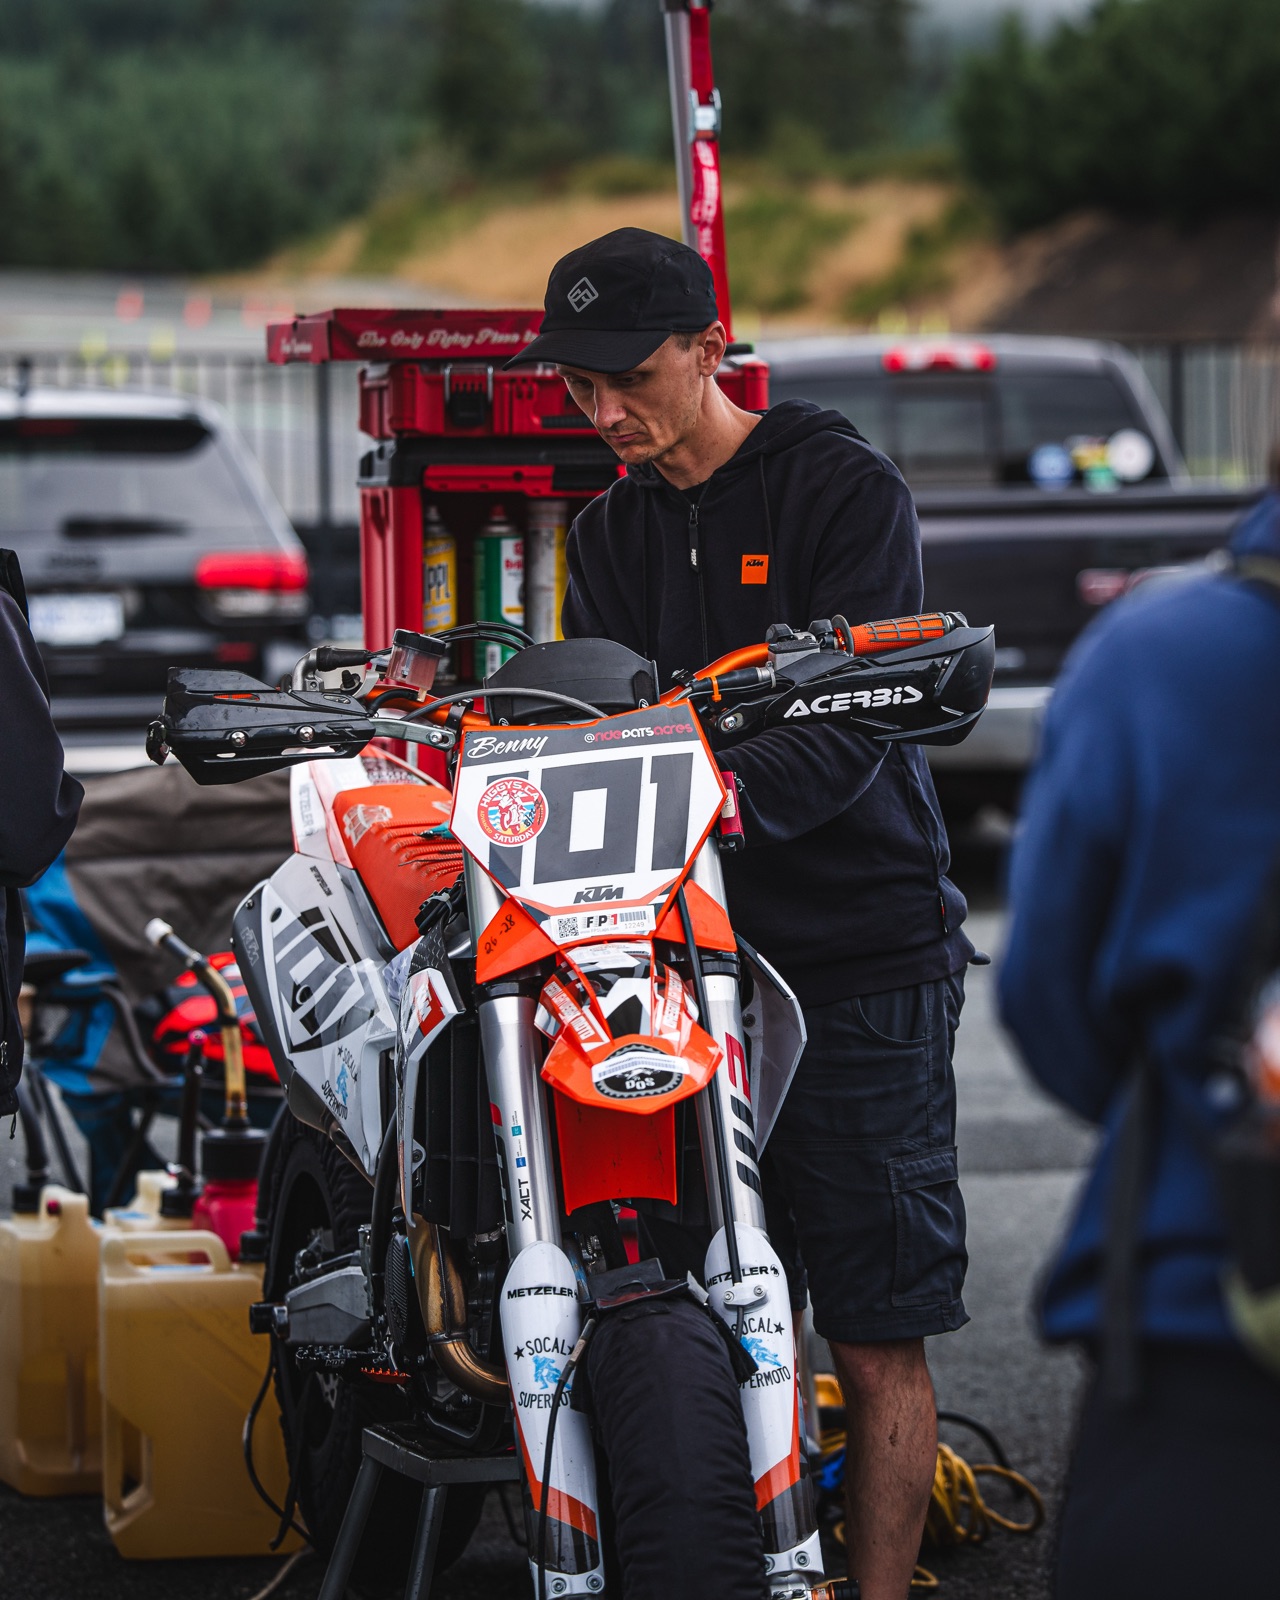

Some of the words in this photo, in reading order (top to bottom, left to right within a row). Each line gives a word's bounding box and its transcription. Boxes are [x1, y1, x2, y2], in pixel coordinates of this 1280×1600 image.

[745, 559, 764, 567] KTM
[783, 685, 924, 719] ACERBIS
[467, 735, 549, 759] Benny
[480, 780, 540, 808] HIGGYS.CA
[480, 810, 493, 834] ADVANCED
[493, 828, 535, 843] SATURDAY
[573, 884, 624, 904] KTM
[625, 922, 645, 930] 12249
[321, 1079, 349, 1121] SUPERMOTO
[518, 1178, 532, 1221] XACT
[707, 1265, 769, 1287] METZLER
[507, 1286, 574, 1300] METZELER
[525, 1336, 567, 1356] SOCAL
[737, 1365, 791, 1390] ERMOTO
[518, 1389, 572, 1409] SUPERO
